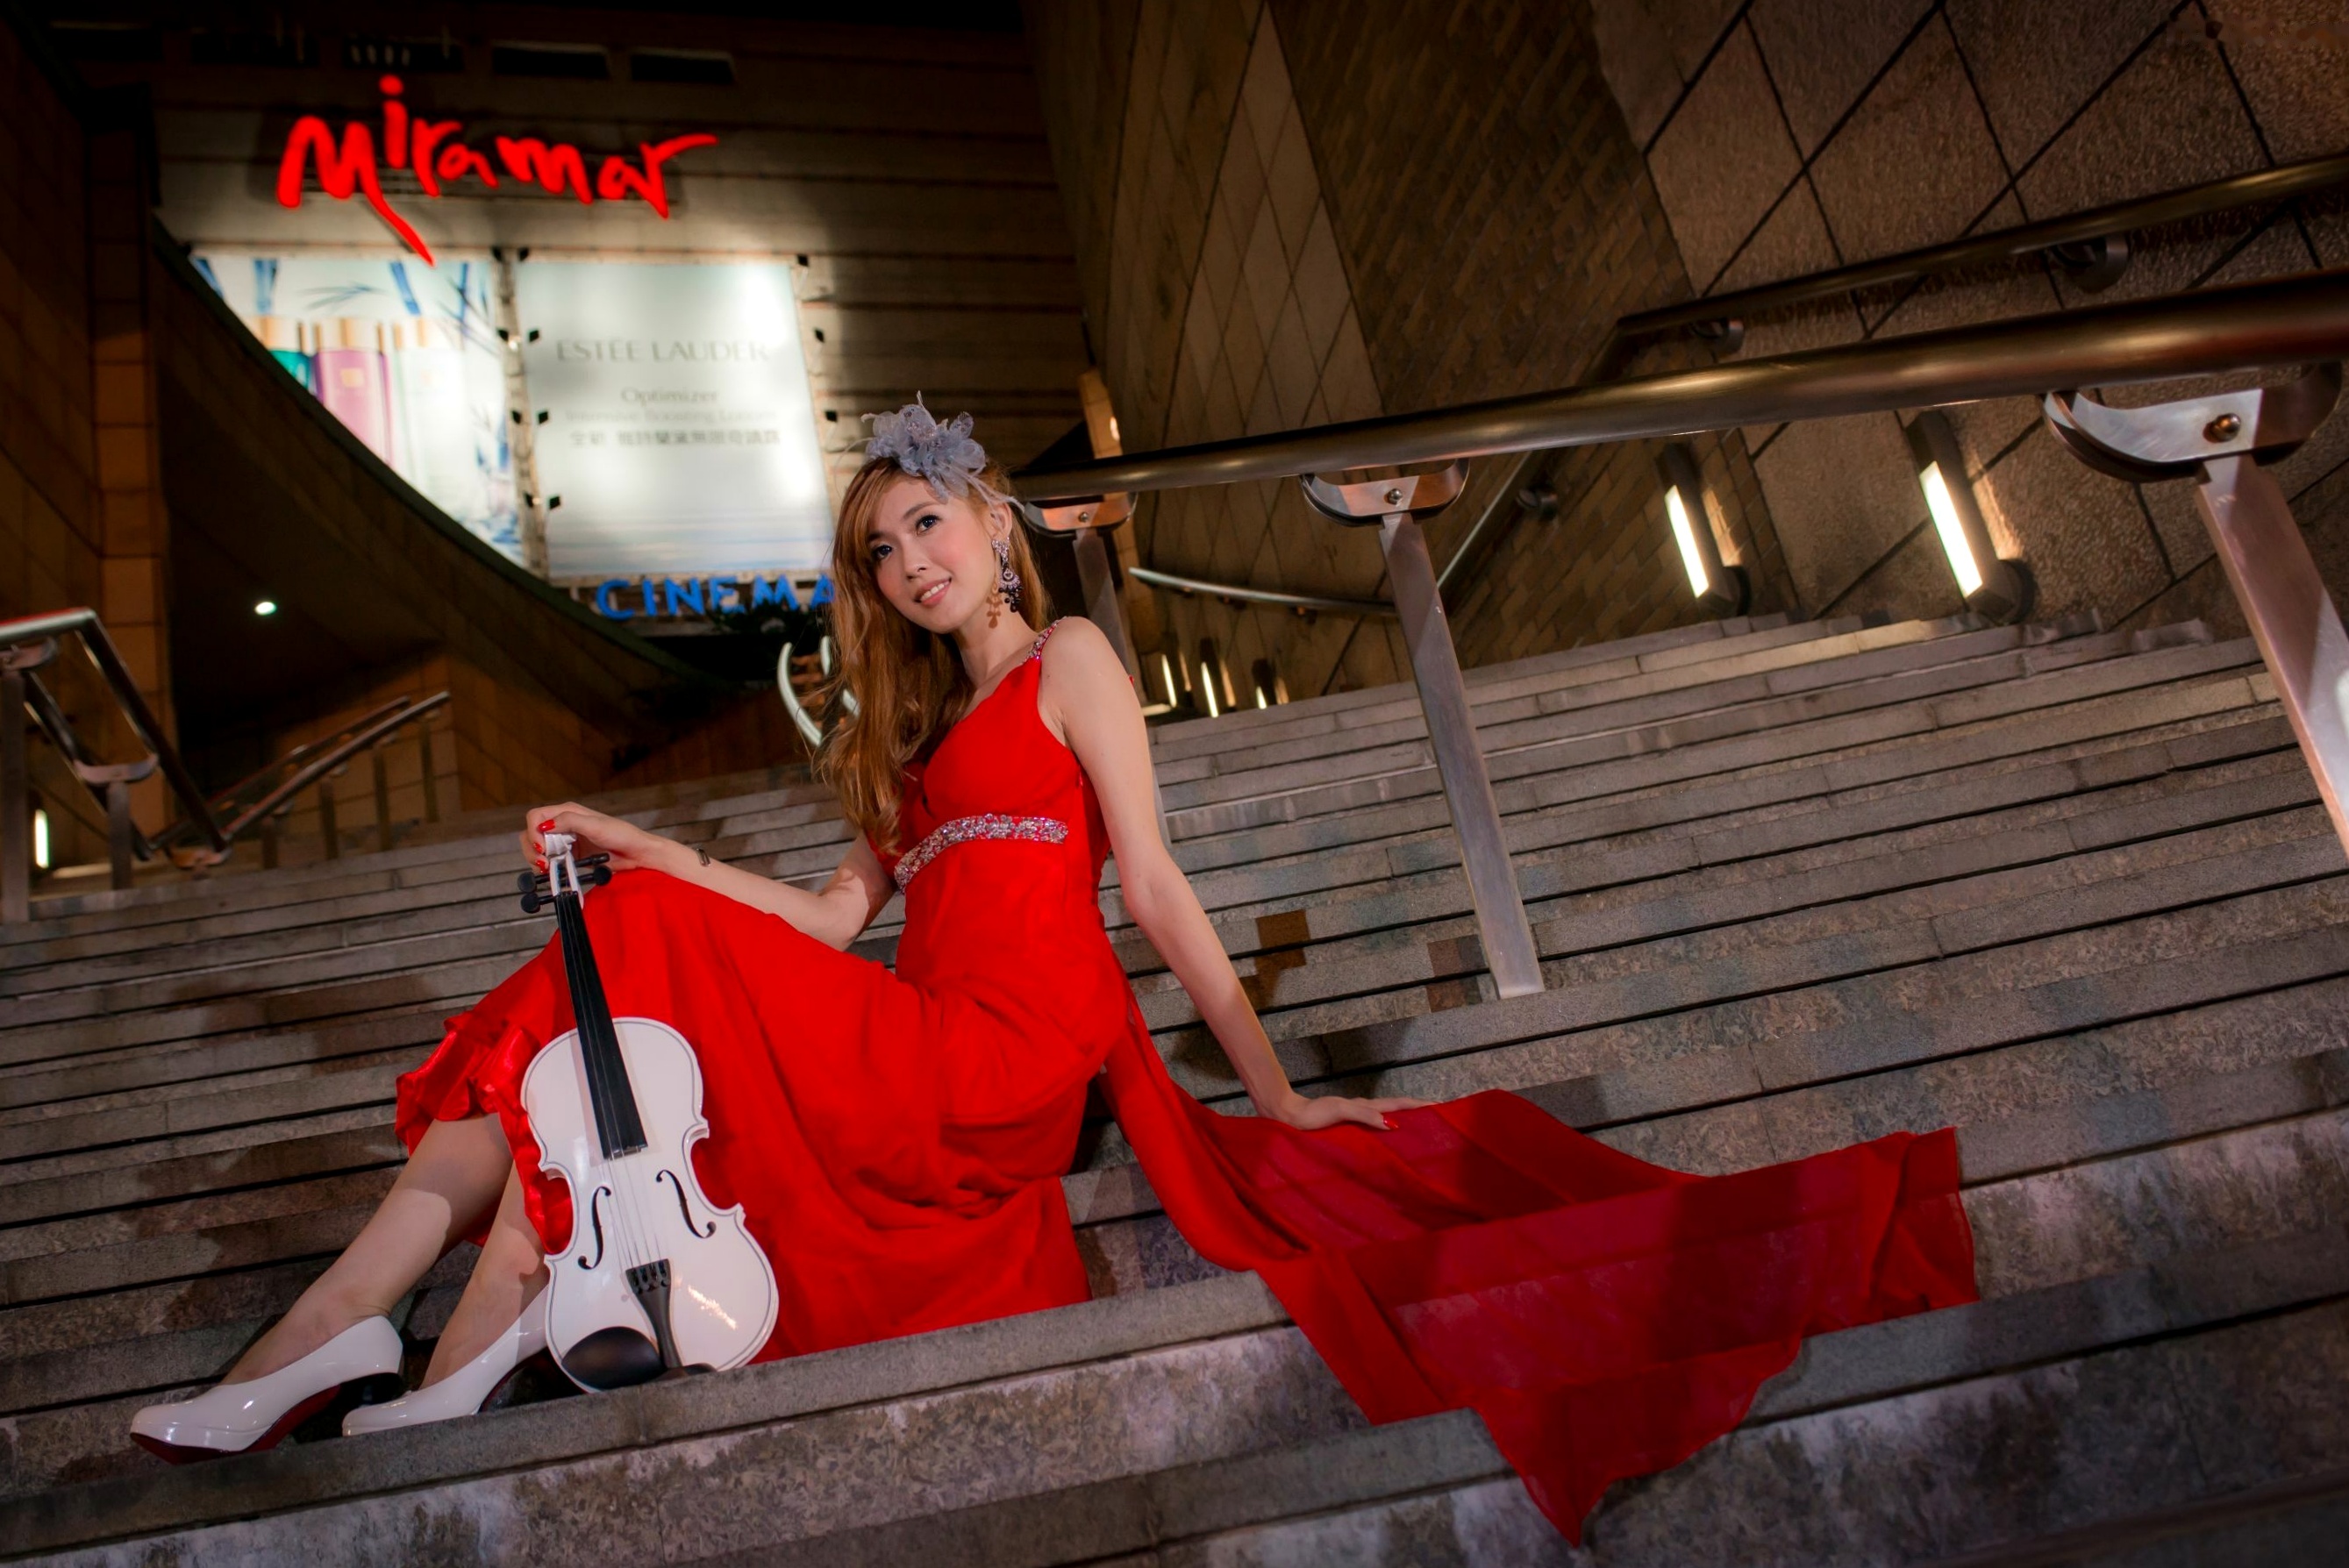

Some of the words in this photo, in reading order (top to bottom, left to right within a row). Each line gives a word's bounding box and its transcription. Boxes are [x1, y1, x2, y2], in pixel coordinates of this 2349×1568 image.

[276, 75, 718, 266] Miramar
[652, 340, 770, 364] LAUDER
[596, 574, 834, 620] CINEMA
